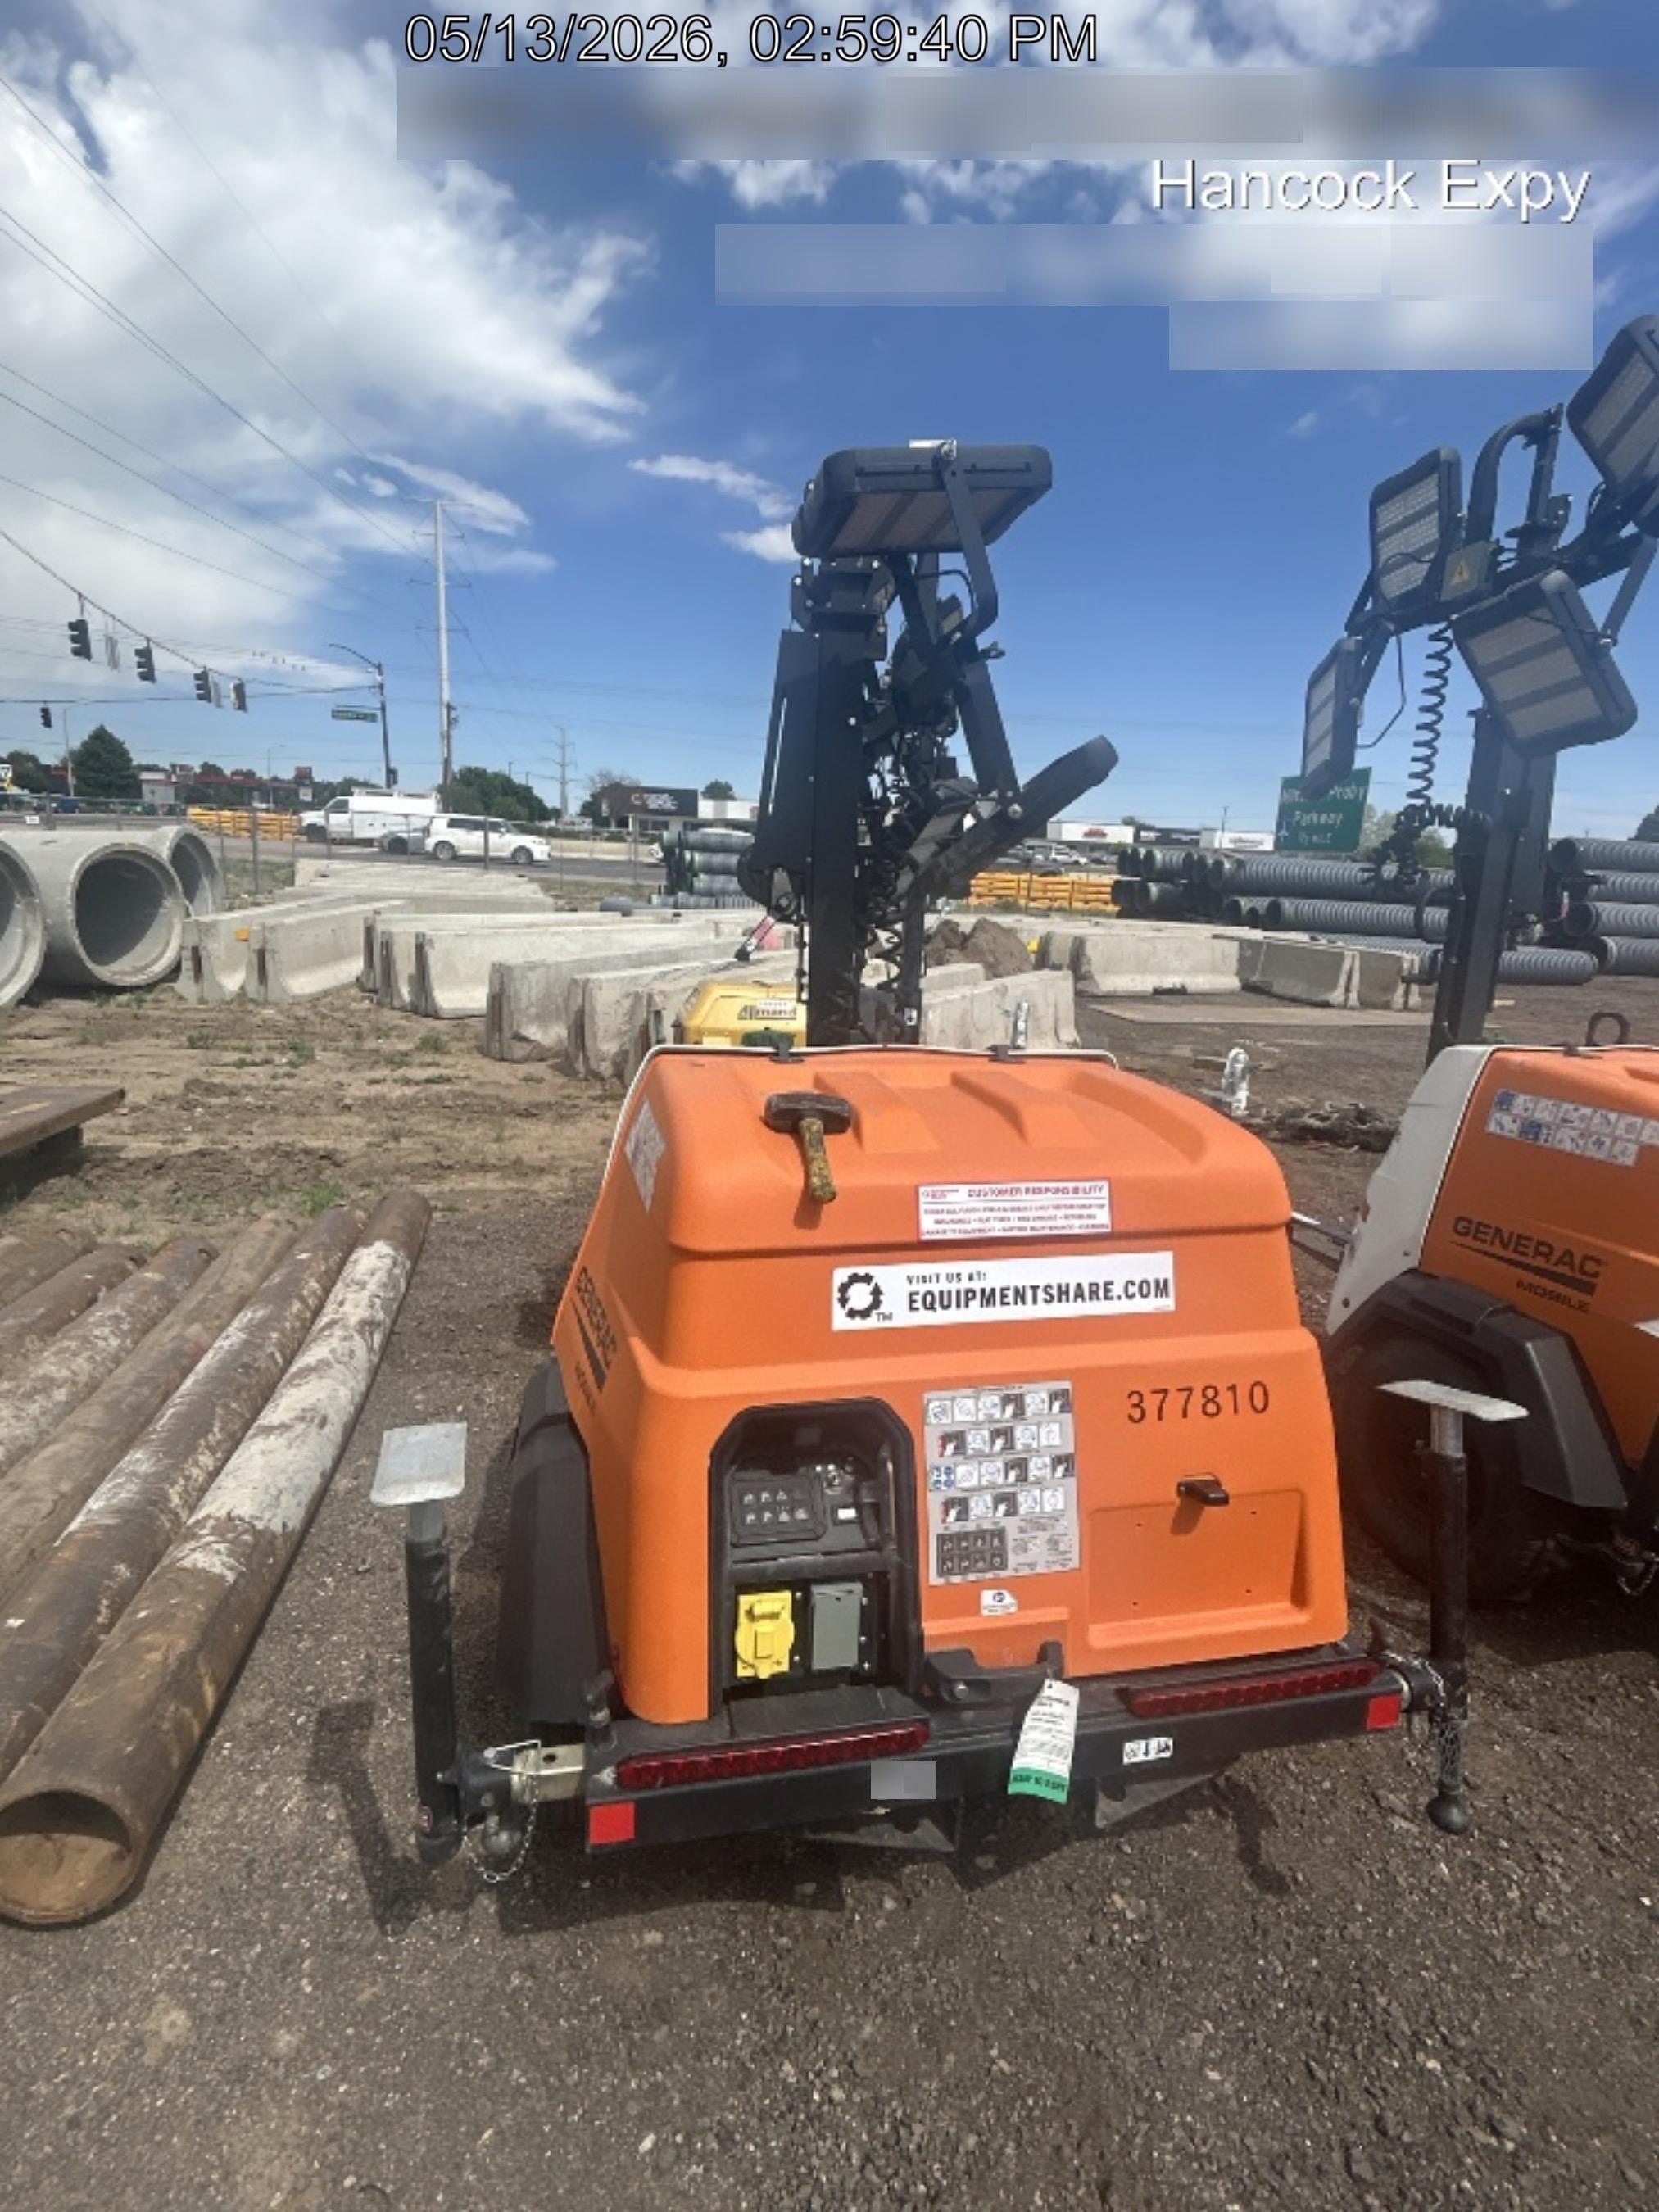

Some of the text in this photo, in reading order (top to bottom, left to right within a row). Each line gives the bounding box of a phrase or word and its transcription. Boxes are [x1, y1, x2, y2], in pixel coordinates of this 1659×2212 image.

[1294, 810, 1344, 829] Parkway
[968, 1186, 1023, 1198] CUSTOMER
[1025, 1184, 1105, 1196] RESPONSIBILITY
[1453, 1215, 1604, 1280] GENERAC
[906, 1270, 986, 1285] VISIT US AT:
[908, 1277, 1171, 1313] EQUIPMENTSHARE.COM
[1126, 1380, 1270, 1424] 377810
